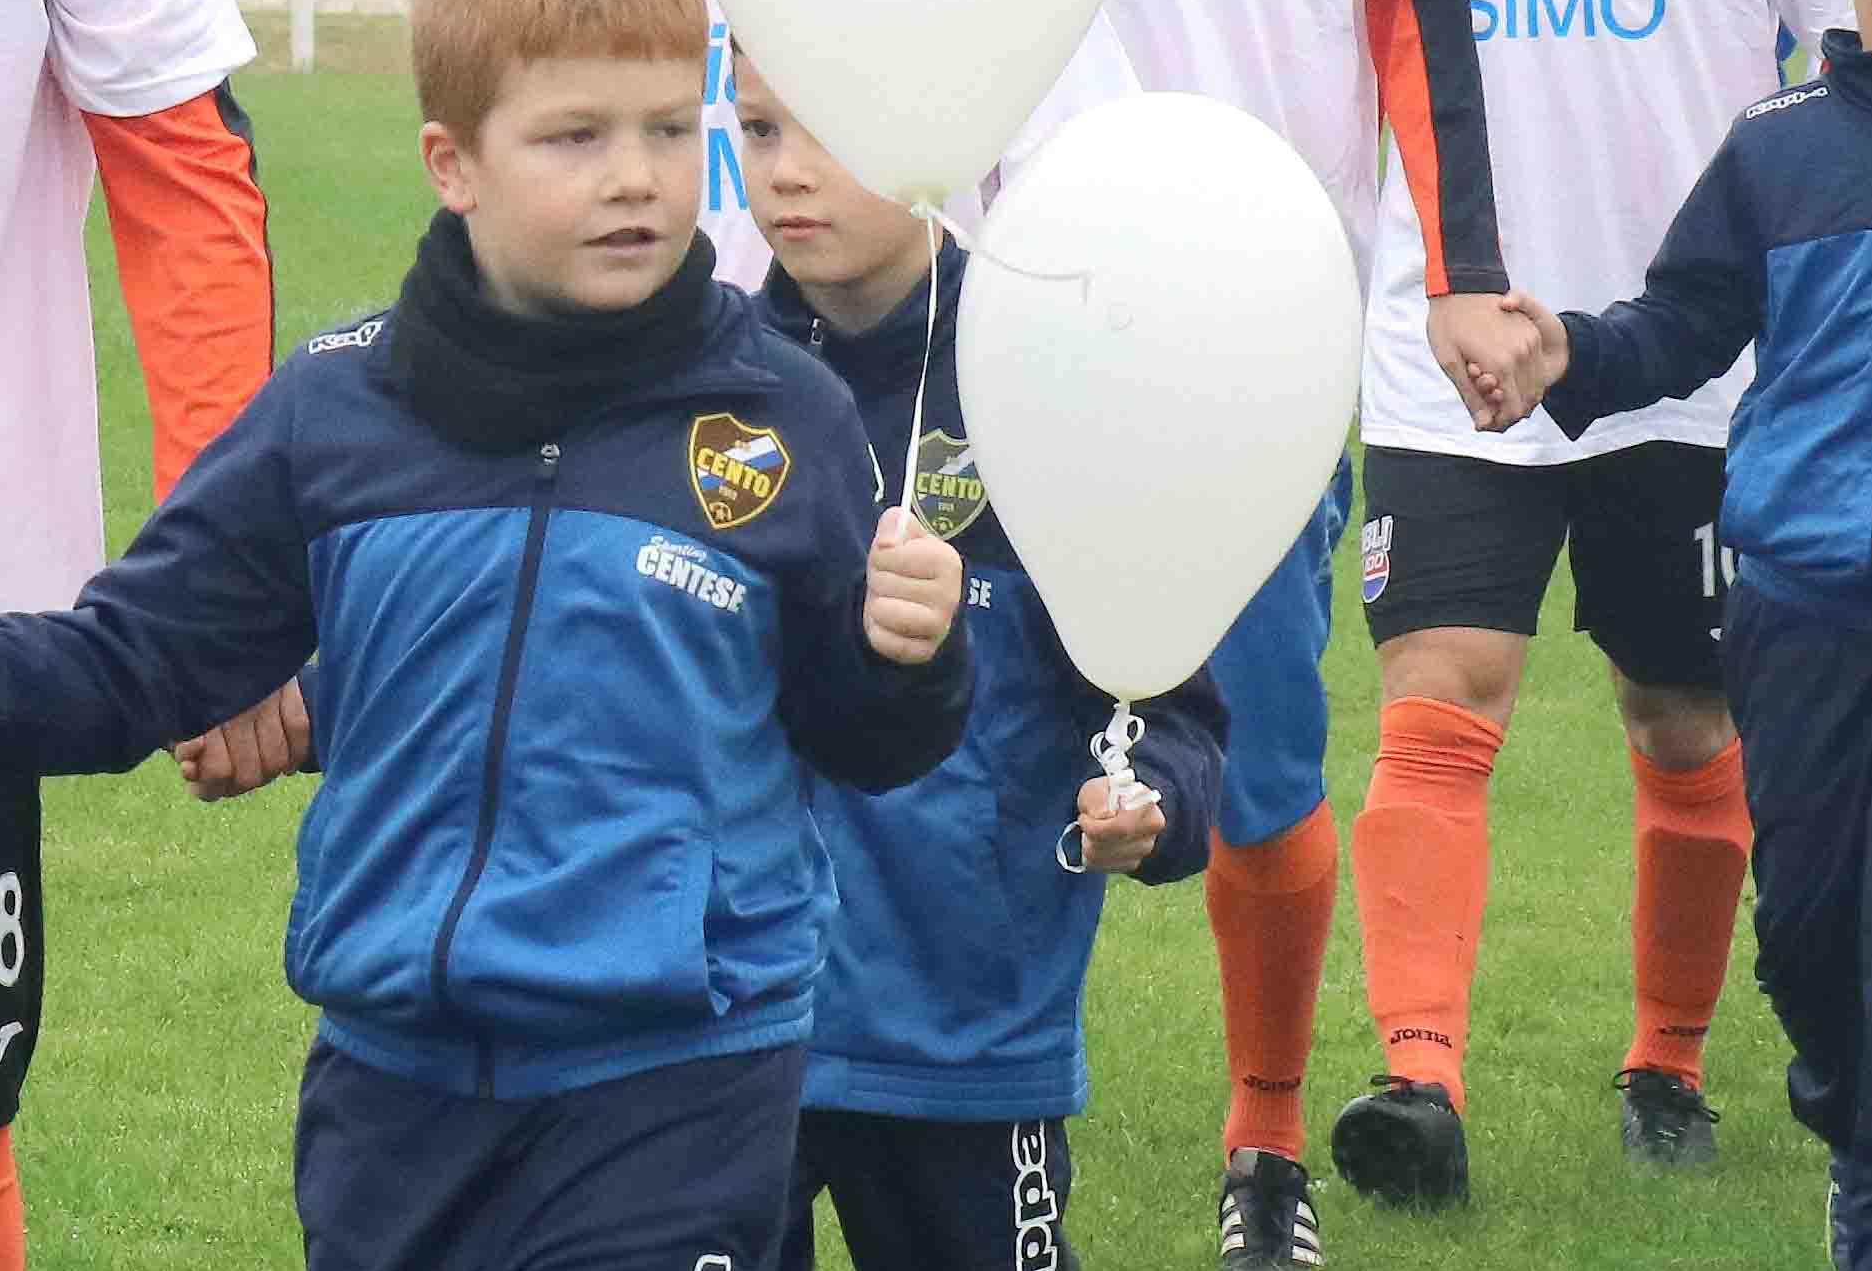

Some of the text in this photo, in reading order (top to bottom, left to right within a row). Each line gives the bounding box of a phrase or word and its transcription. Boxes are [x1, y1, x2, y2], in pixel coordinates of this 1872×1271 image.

[694, 446, 772, 500] CENTO
[917, 472, 985, 501] CENTO
[636, 544, 748, 614] CENTESE
